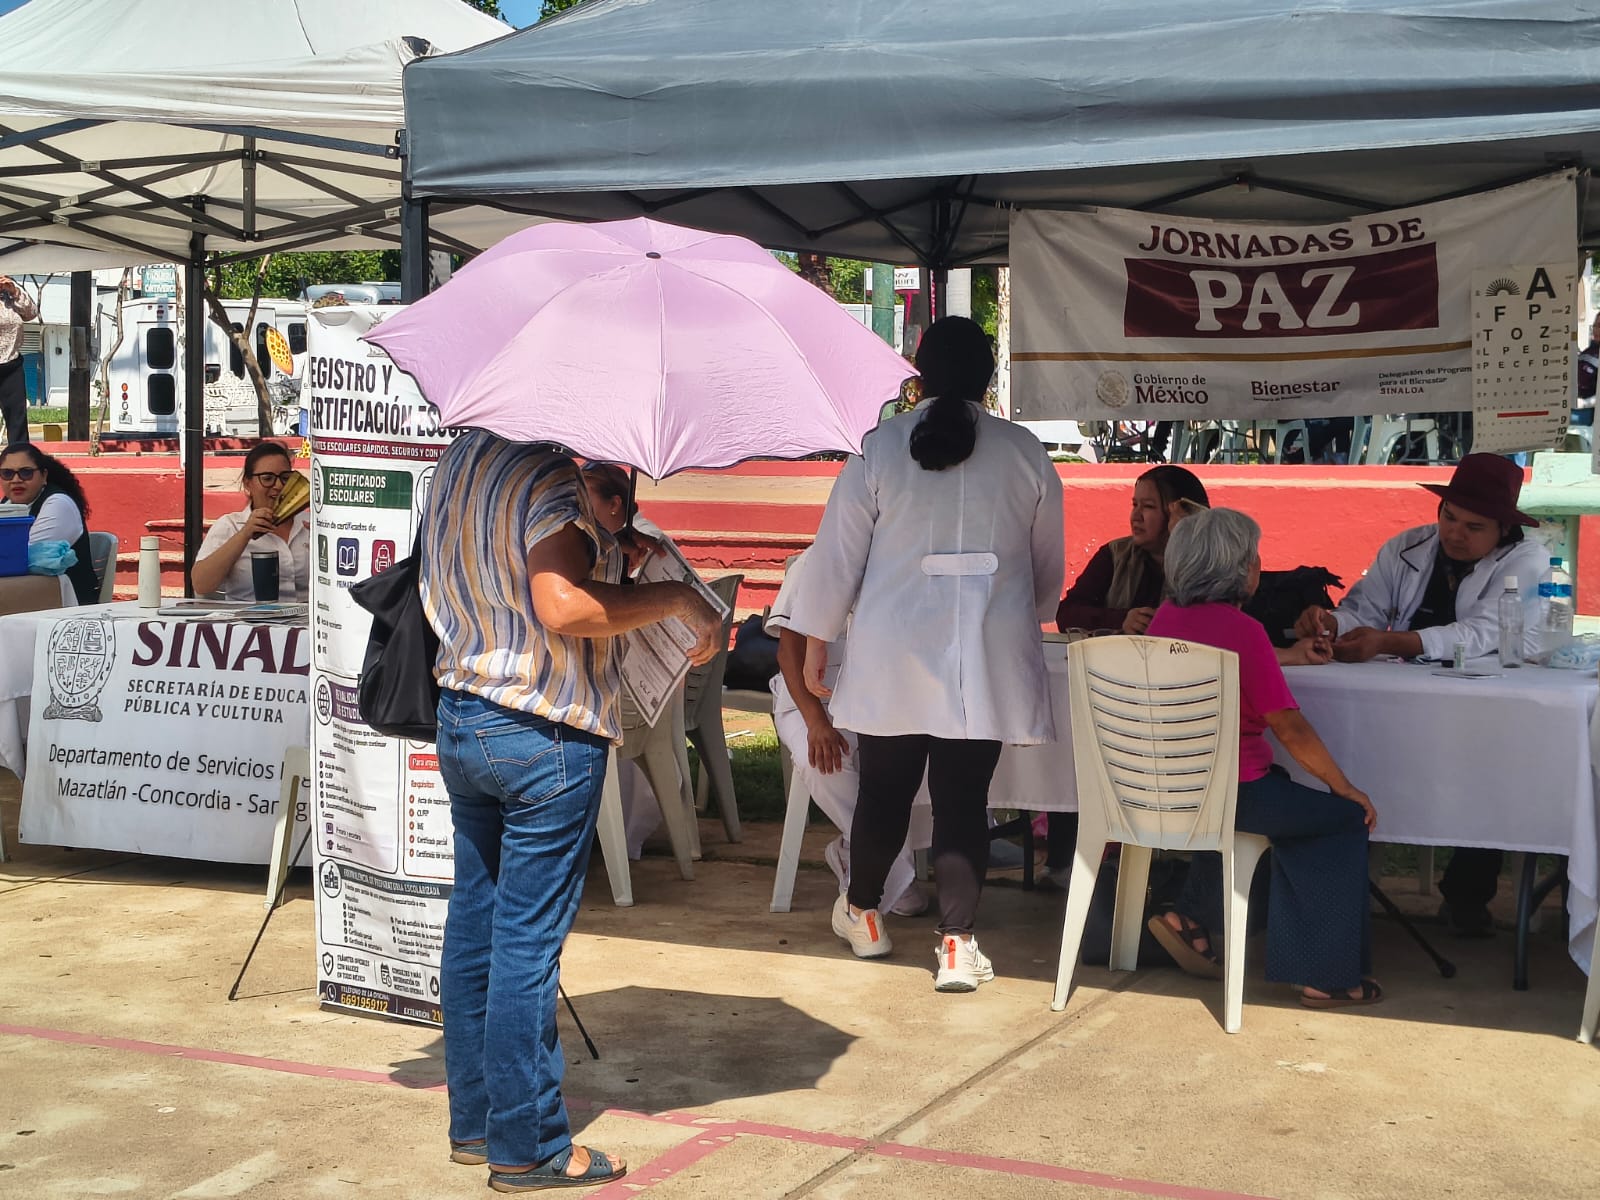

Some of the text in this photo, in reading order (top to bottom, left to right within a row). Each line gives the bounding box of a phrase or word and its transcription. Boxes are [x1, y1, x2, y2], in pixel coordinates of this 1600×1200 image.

[1138, 217, 1426, 259] JORNADAS DE
[1526, 267, 1557, 301] A
[1566, 283, 1572, 292] 1
[1188, 266, 1360, 331] PAZ
[1494, 304, 1571, 322] F P 2
[1483, 325, 1570, 342] T O Z 3
[1483, 342, 1569, 356] L P E D 4
[1483, 362, 1489, 370] P
[1498, 361, 1505, 369] E
[1513, 360, 1520, 368] C
[1562, 356, 1569, 366] 5
[382, 365, 393, 396] Y
[1134, 373, 1206, 385] Gobierno de
[1562, 372, 1568, 381] 6
[1135, 385, 1209, 404] México
[1251, 380, 1341, 396] Bienestar
[1380, 386, 1424, 394] SINALOA
[1562, 386, 1568, 395] 7
[1562, 400, 1568, 409] 8
[1560, 415, 1567, 425] 9
[327, 442, 361, 454] ESCOLARES
[391, 446, 418, 457] SEGUROS
[419, 447, 424, 457] Y
[425, 448, 438, 458] CON
[329, 472, 386, 489] CERTIFICADOS
[329, 489, 375, 504] ESCOLARES
[127, 680, 307, 704] SECRETARÍA DE EDUCA
[124, 698, 284, 724] PÚBLICA Y CULTURA
[49, 744, 162, 769] Departamento
[166, 751, 191, 772] de
[196, 755, 275, 780] Servicios
[58, 777, 126, 801] Mazatlán
[132, 784, 231, 811] -Concordia
[341, 994, 388, 1012] 6691959112
